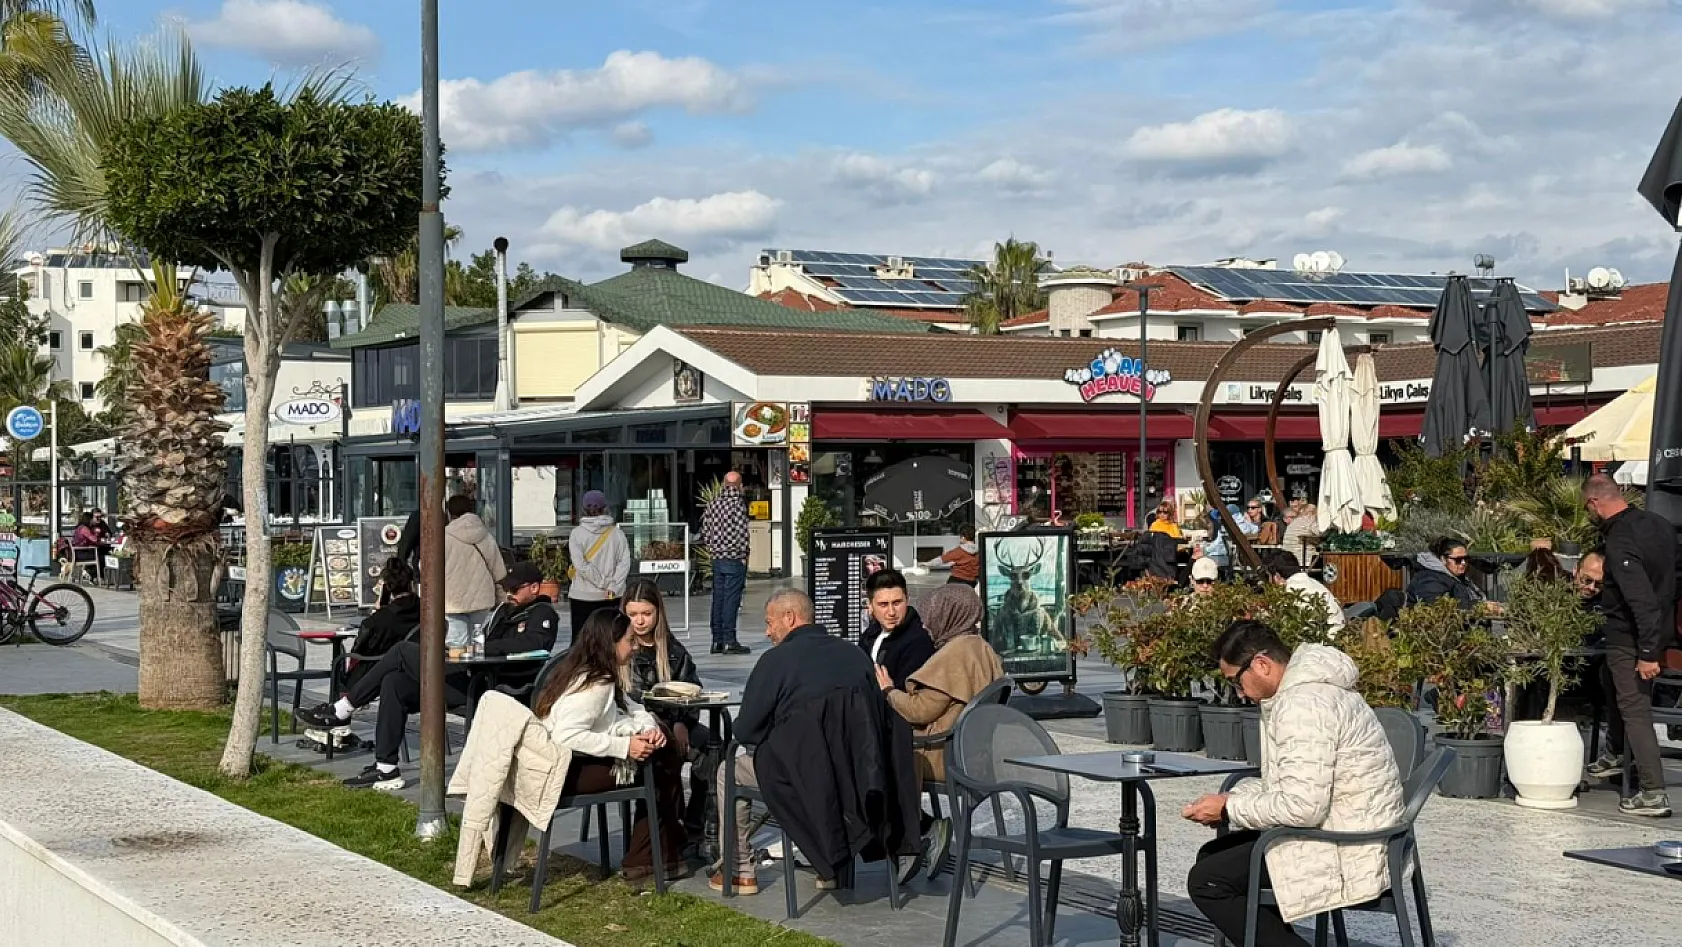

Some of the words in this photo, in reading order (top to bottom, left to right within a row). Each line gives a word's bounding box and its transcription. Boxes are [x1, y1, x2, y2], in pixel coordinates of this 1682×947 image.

[872, 377, 951, 401] MADO
[1381, 385, 1403, 402] Likya
[288, 402, 330, 415] MADO
